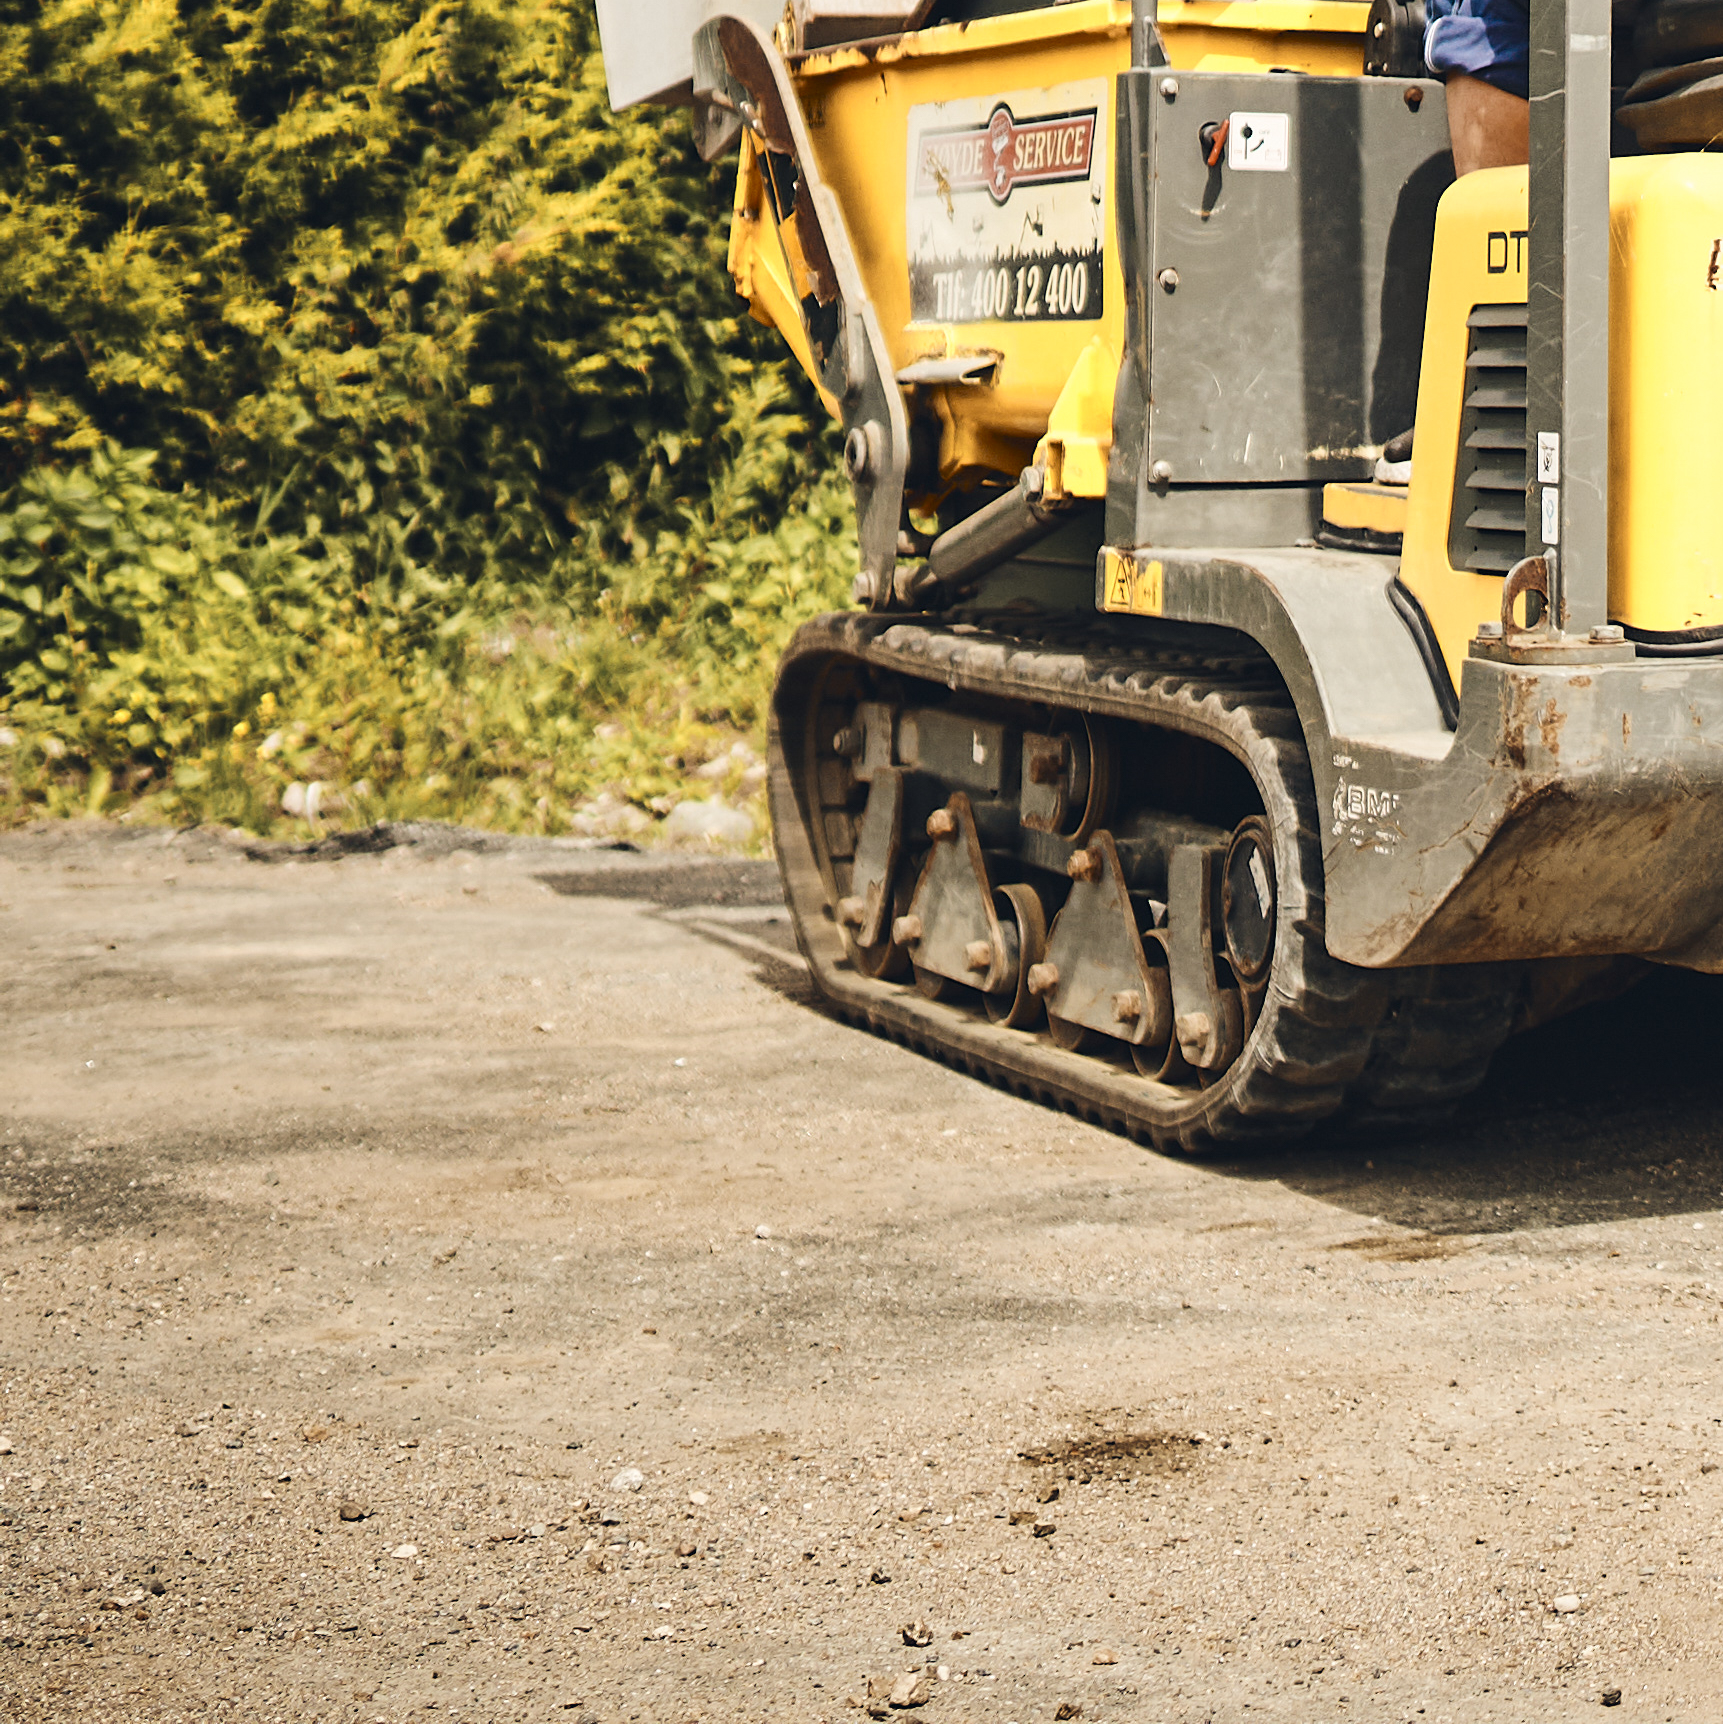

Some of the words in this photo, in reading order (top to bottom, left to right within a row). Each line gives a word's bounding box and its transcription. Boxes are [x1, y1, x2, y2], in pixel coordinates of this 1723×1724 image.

[1013, 125, 1086, 171] SERVICE
[1487, 230, 1528, 274] DT
[932, 269, 965, 320] Tlf:
[971, 267, 1010, 318] 400
[1013, 264, 1041, 316] 12
[1045, 261, 1088, 315] 400
